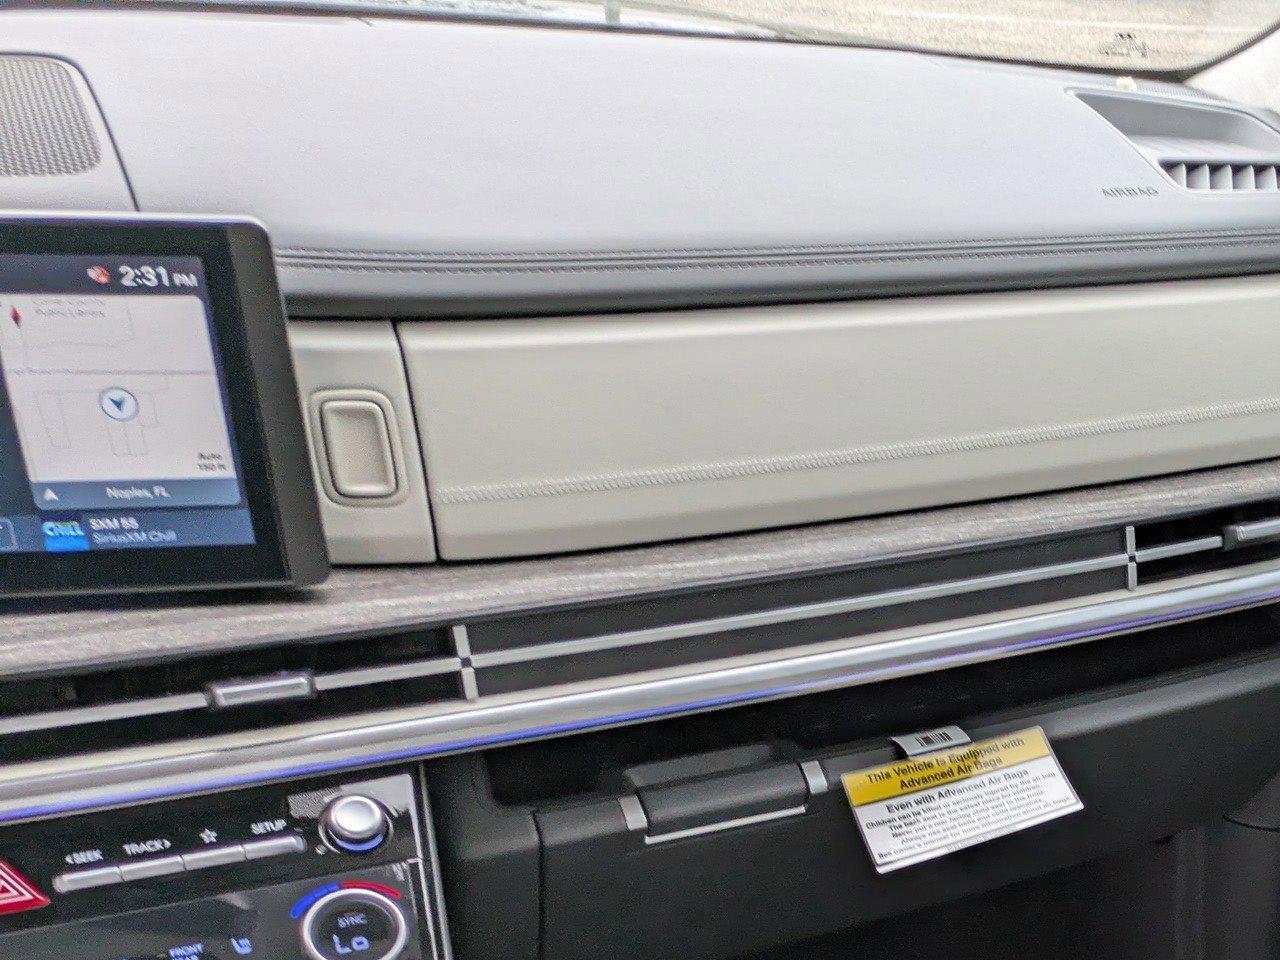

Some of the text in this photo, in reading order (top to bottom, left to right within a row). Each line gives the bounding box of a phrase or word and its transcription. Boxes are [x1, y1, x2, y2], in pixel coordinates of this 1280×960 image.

[1101, 186, 1159, 198] AIRBAG
[119, 265, 170, 287] 2:31
[868, 771, 890, 782] This
[894, 760, 933, 776] Vehicle
[948, 744, 999, 763] Equipped
[1001, 738, 1024, 749] with
[899, 756, 1003, 789] Advanced Air Bags
[887, 768, 1029, 813] Even with Advanced Air Bags
[74, 819, 287, 864] SEEK TRACK SETUP
[338, 913, 368, 929] SYNC
